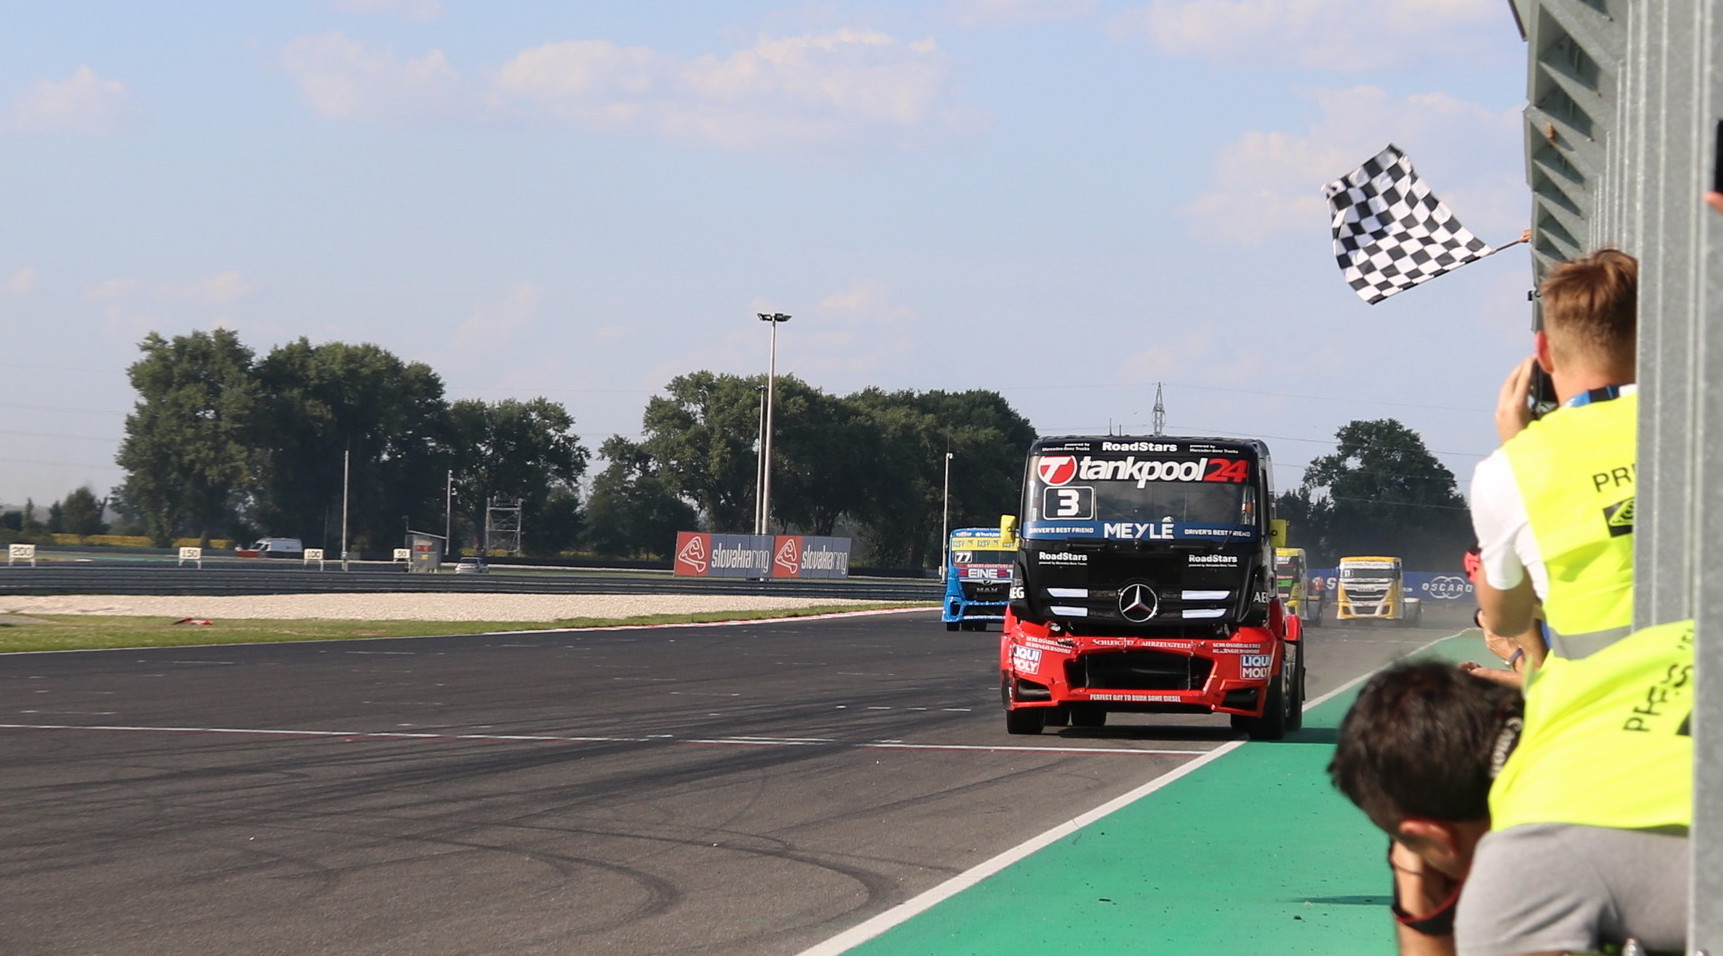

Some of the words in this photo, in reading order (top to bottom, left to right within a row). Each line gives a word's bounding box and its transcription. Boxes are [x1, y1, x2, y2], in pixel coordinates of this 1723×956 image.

[1102, 442, 1178, 452] RoadStars
[1079, 455, 1249, 489] tankpool24
[1057, 489, 1080, 517] 3
[1103, 521, 1175, 539] MEYLE
[12, 545, 34, 557] 200
[181, 549, 199, 558] 150
[306, 550, 321, 559] 100
[956, 552, 971, 561] 77
[1038, 551, 1088, 562] RoadStars
[711, 543, 770, 574] slovakiaring
[801, 544, 848, 575] slovakiaring
[1188, 554, 1238, 563] RoadStars
[1422, 582, 1473, 593] OSCARO
[1252, 591, 1271, 604] AE
[1242, 655, 1271, 667] LIQU
[1089, 693, 1112, 701] PERFECT
[1124, 694, 1132, 702] TO
